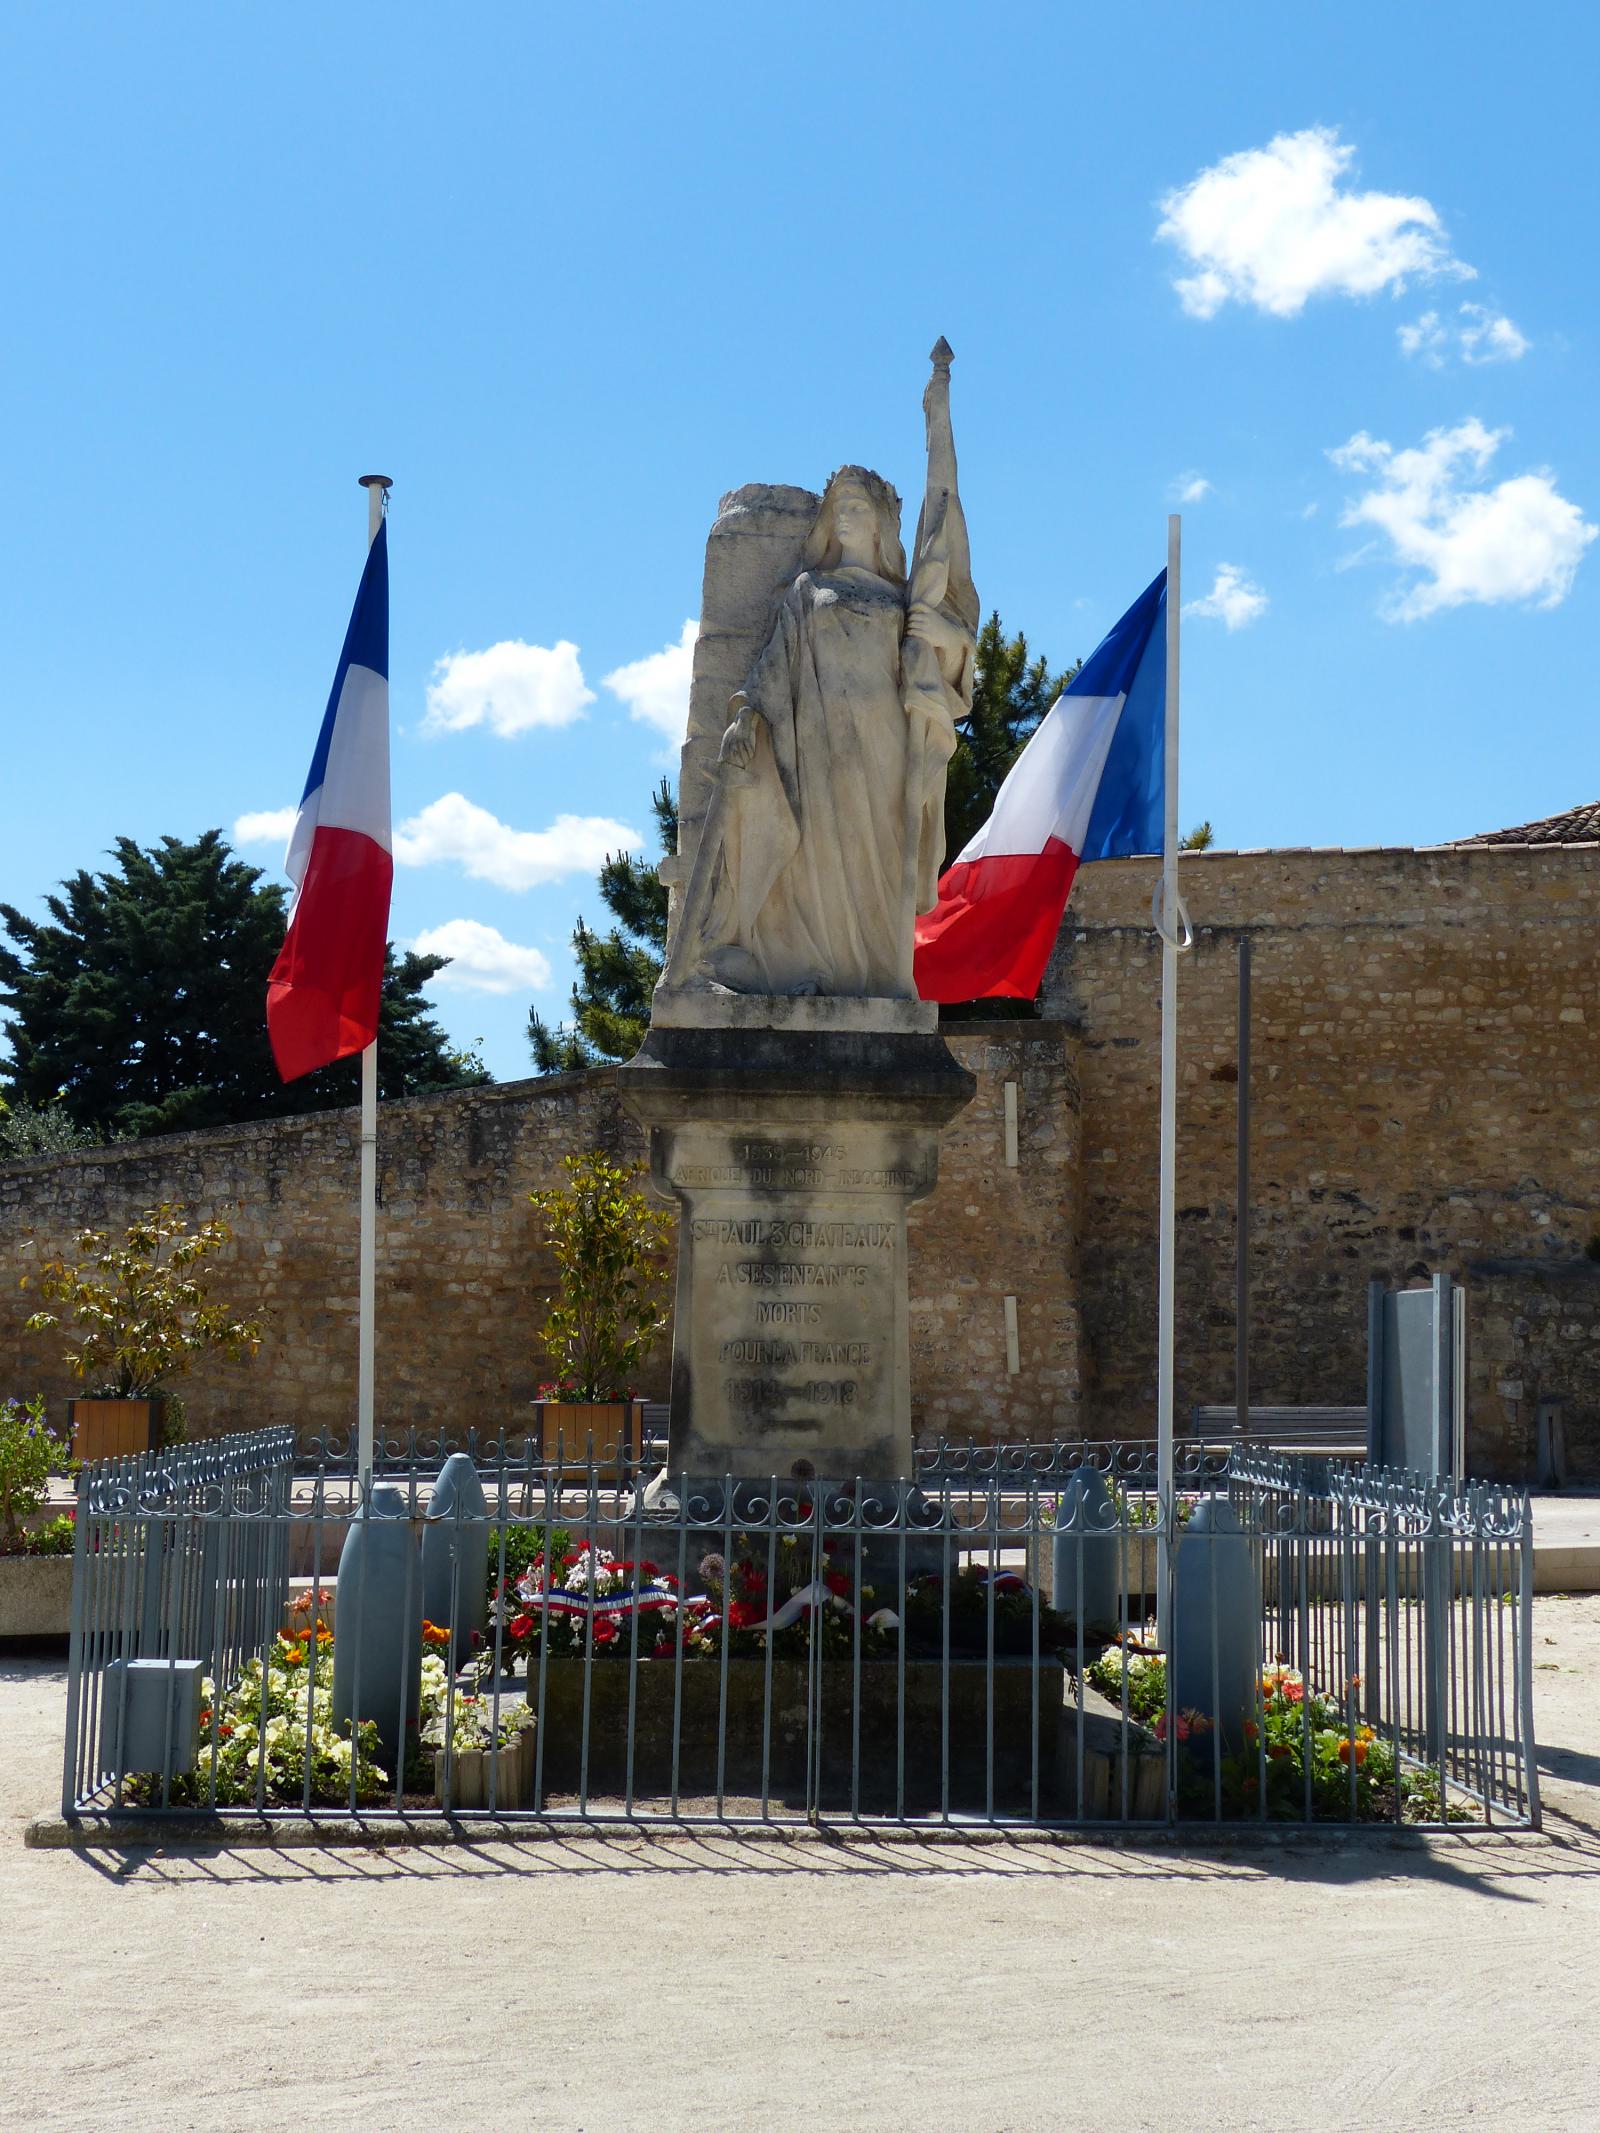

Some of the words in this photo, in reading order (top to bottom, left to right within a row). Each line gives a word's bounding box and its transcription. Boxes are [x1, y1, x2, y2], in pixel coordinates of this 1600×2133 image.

[675, 1166, 742, 1184] AFRIQUE
[752, 1168, 772, 1184] DU
[784, 1169, 824, 1185] NORD
[718, 1221, 765, 1246] PAUL
[769, 1222, 787, 1247] 3
[788, 1222, 896, 1249] CHATEAUX
[717, 1264, 735, 1286] A
[736, 1264, 777, 1286] SES
[755, 1303, 823, 1325] MORTS
[719, 1341, 771, 1364] POUR
[799, 1343, 872, 1366] FRANCE
